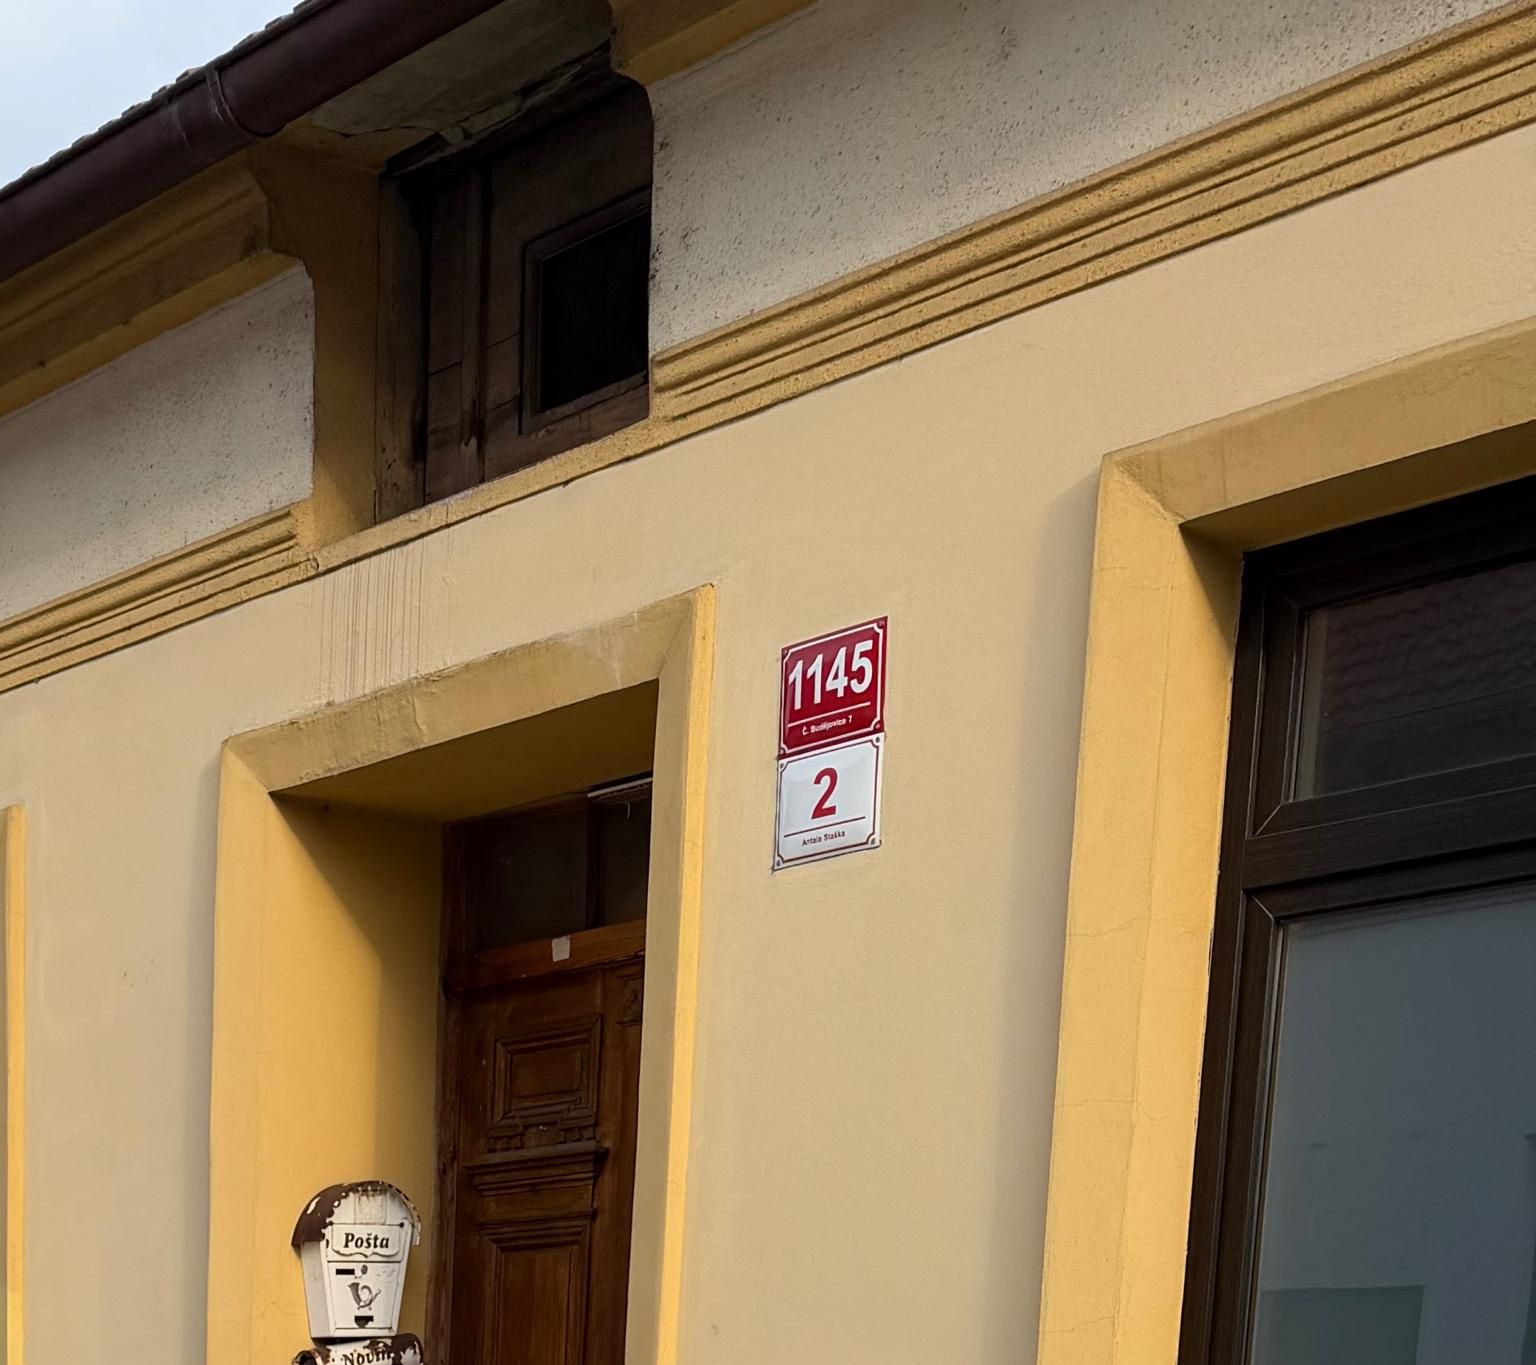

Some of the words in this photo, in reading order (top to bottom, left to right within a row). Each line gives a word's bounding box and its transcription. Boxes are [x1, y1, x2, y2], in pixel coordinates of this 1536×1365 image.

[788, 639, 873, 710] 1145
[811, 767, 838, 820] 2
[344, 1232, 389, 1249] Pošta
